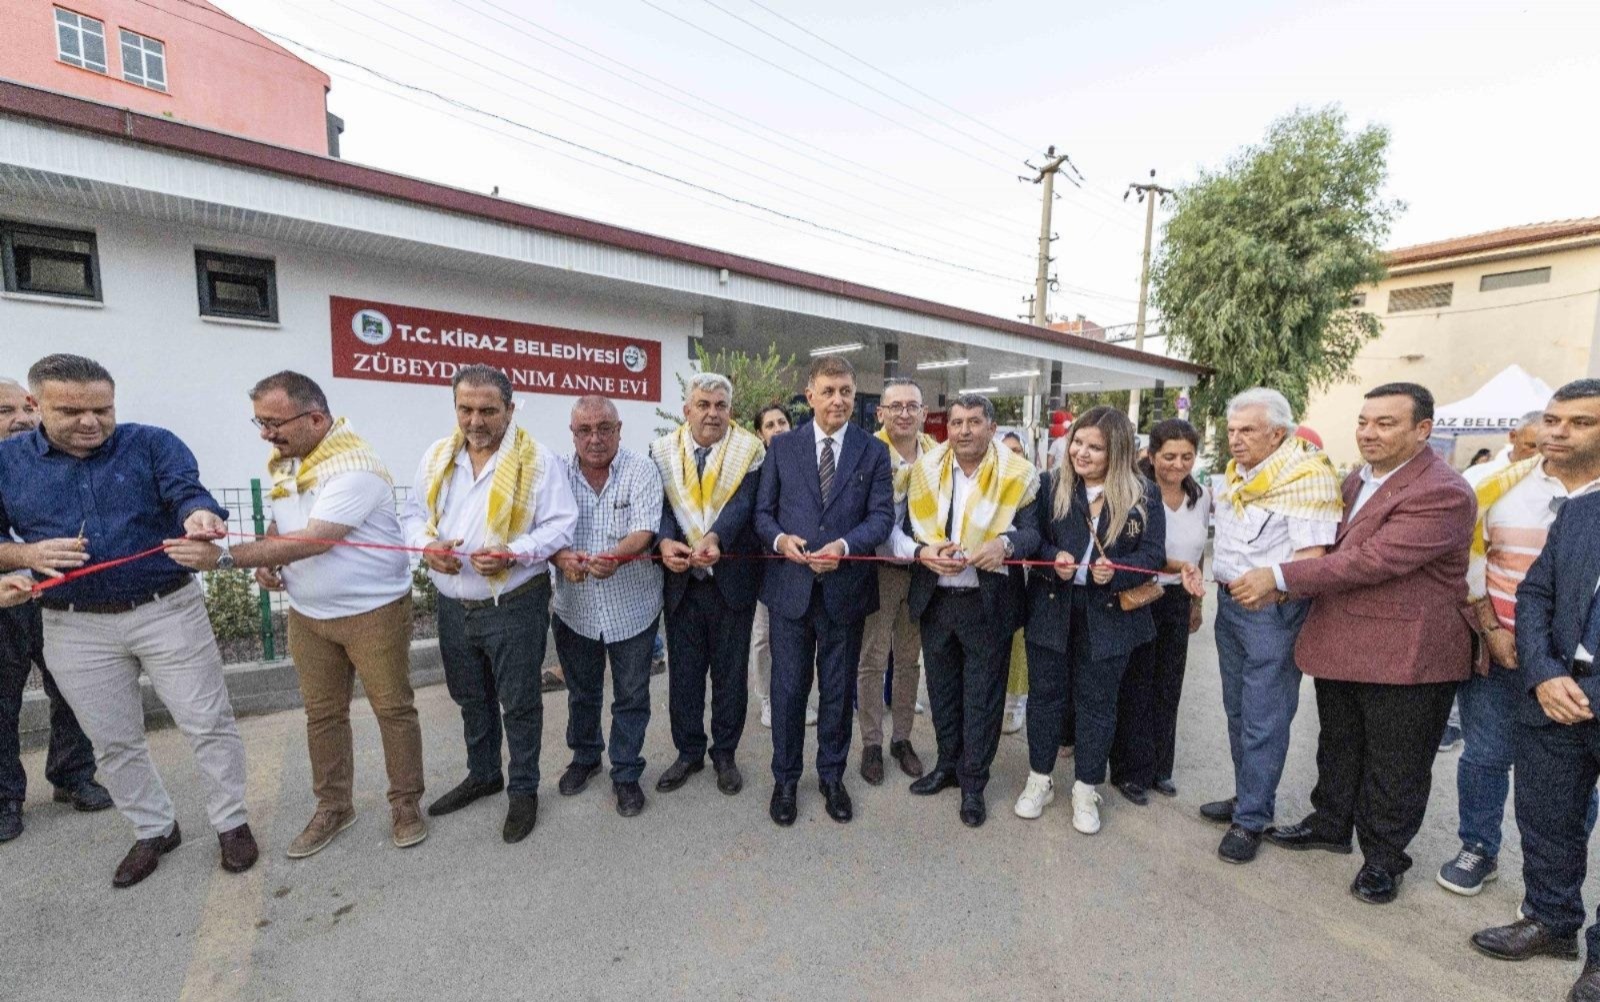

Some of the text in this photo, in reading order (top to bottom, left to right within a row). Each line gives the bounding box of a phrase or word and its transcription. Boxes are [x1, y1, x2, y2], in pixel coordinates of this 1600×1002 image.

[396, 323, 620, 365] T.C. KİRAZ BELEDİYESİ
[352, 352, 471, 379] ZÜBEYD
[560, 373, 615, 393] ANNE
[619, 378, 648, 395] EVİ
[1463, 417, 1520, 427] BELED
